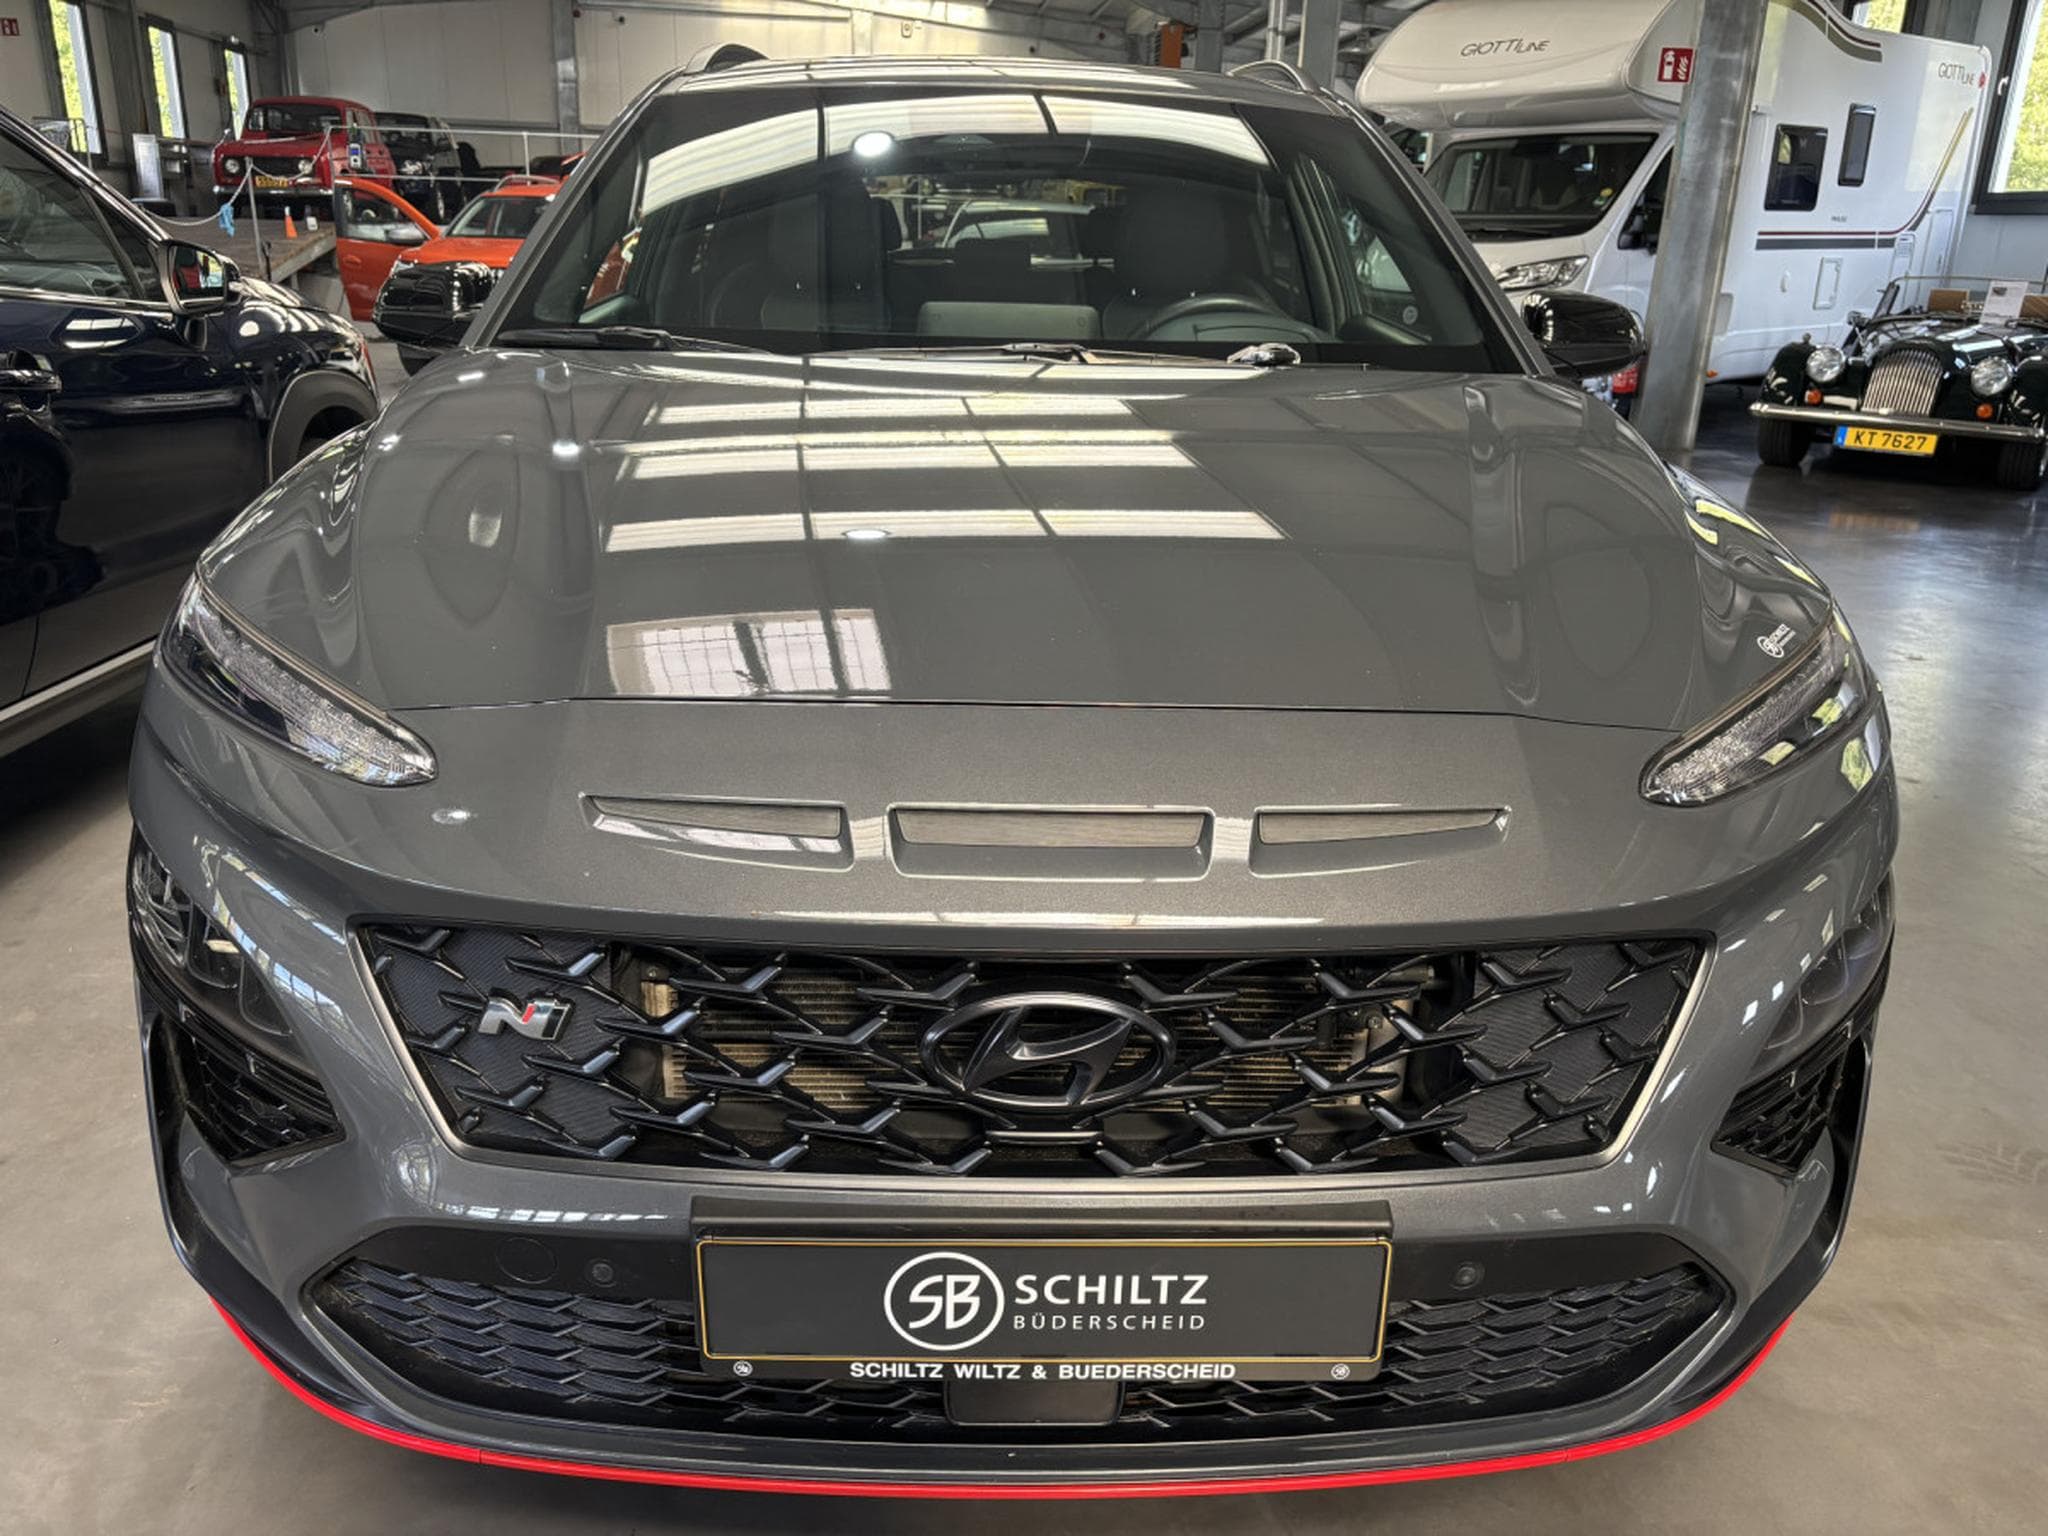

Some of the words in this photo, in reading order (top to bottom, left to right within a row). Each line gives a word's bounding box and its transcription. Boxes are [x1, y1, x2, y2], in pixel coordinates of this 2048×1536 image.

[1853, 429, 1878, 447] KT
[1881, 432, 1929, 451] 7627
[1014, 1274, 1210, 1306] SCHILTZ
[908, 1274, 982, 1331] SB
[1013, 1312, 1206, 1331] BÜDERSCHEID
[850, 1361, 944, 1379] SCHILTZ
[953, 1363, 1022, 1380] WILTZ
[1031, 1364, 1048, 1381] &
[1058, 1363, 1237, 1380] BUEDERSCHEID
